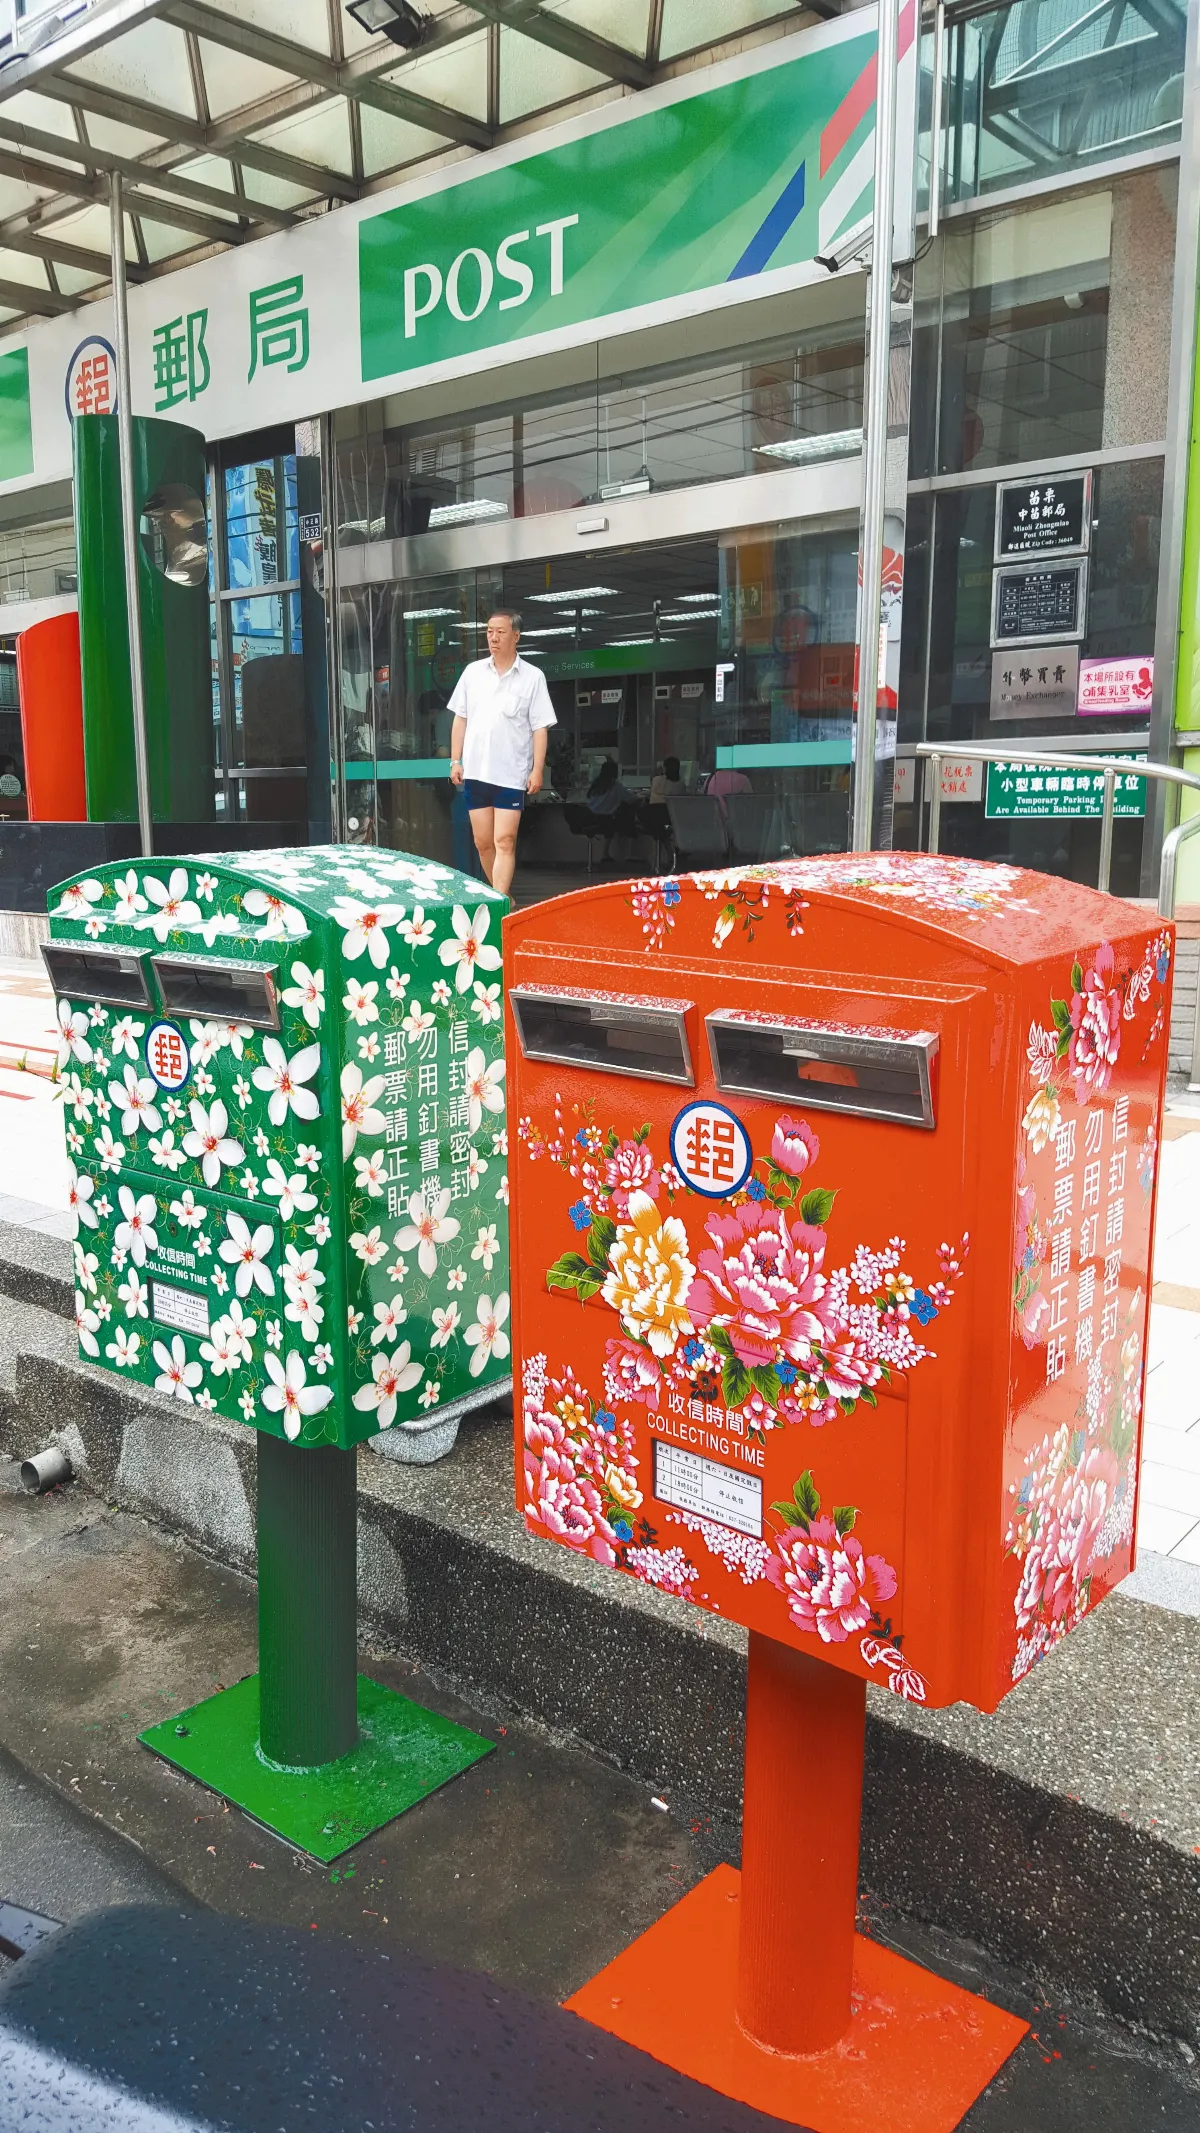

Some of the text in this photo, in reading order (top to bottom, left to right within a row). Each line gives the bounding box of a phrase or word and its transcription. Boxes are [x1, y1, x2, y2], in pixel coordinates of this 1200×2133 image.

[404, 213, 579, 338] POST
[152, 272, 310, 413] 郵局
[1029, 487, 1056, 506] 苗栗
[1018, 502, 1066, 521] 中苗郵局
[305, 527, 320, 538] 532
[1013, 523, 1033, 532] Miaoli
[1023, 529, 1058, 539] Post Office
[561, 660, 595, 672] Services
[1002, 665, 1067, 687] 外幣買賣
[1083, 670, 1136, 683] 本場所設有
[995, 806, 1010, 814] Are
[1013, 804, 1050, 814] Available
[1052, 804, 1081, 814] Behind
[1085, 804, 1100, 814] The
[1016, 795, 1059, 806] Temporary
[1063, 794, 1096, 805] Parking
[417, 1026, 442, 1210] 勿用釘書機
[447, 1020, 471, 1202] 信封請密封
[383, 1030, 410, 1220] 郵票請正貼
[1100, 1094, 1130, 1349] 信封請密封
[1074, 1108, 1104, 1366] 勿用釘書機
[156, 1245, 196, 1270] 收信時間
[1045, 1118, 1077, 1387] 郵票請正貼
[144, 1259, 208, 1286] COLLECTING TIME
[667, 1392, 744, 1436] 收信時間
[647, 1411, 766, 1468] COLLECTING TIME
